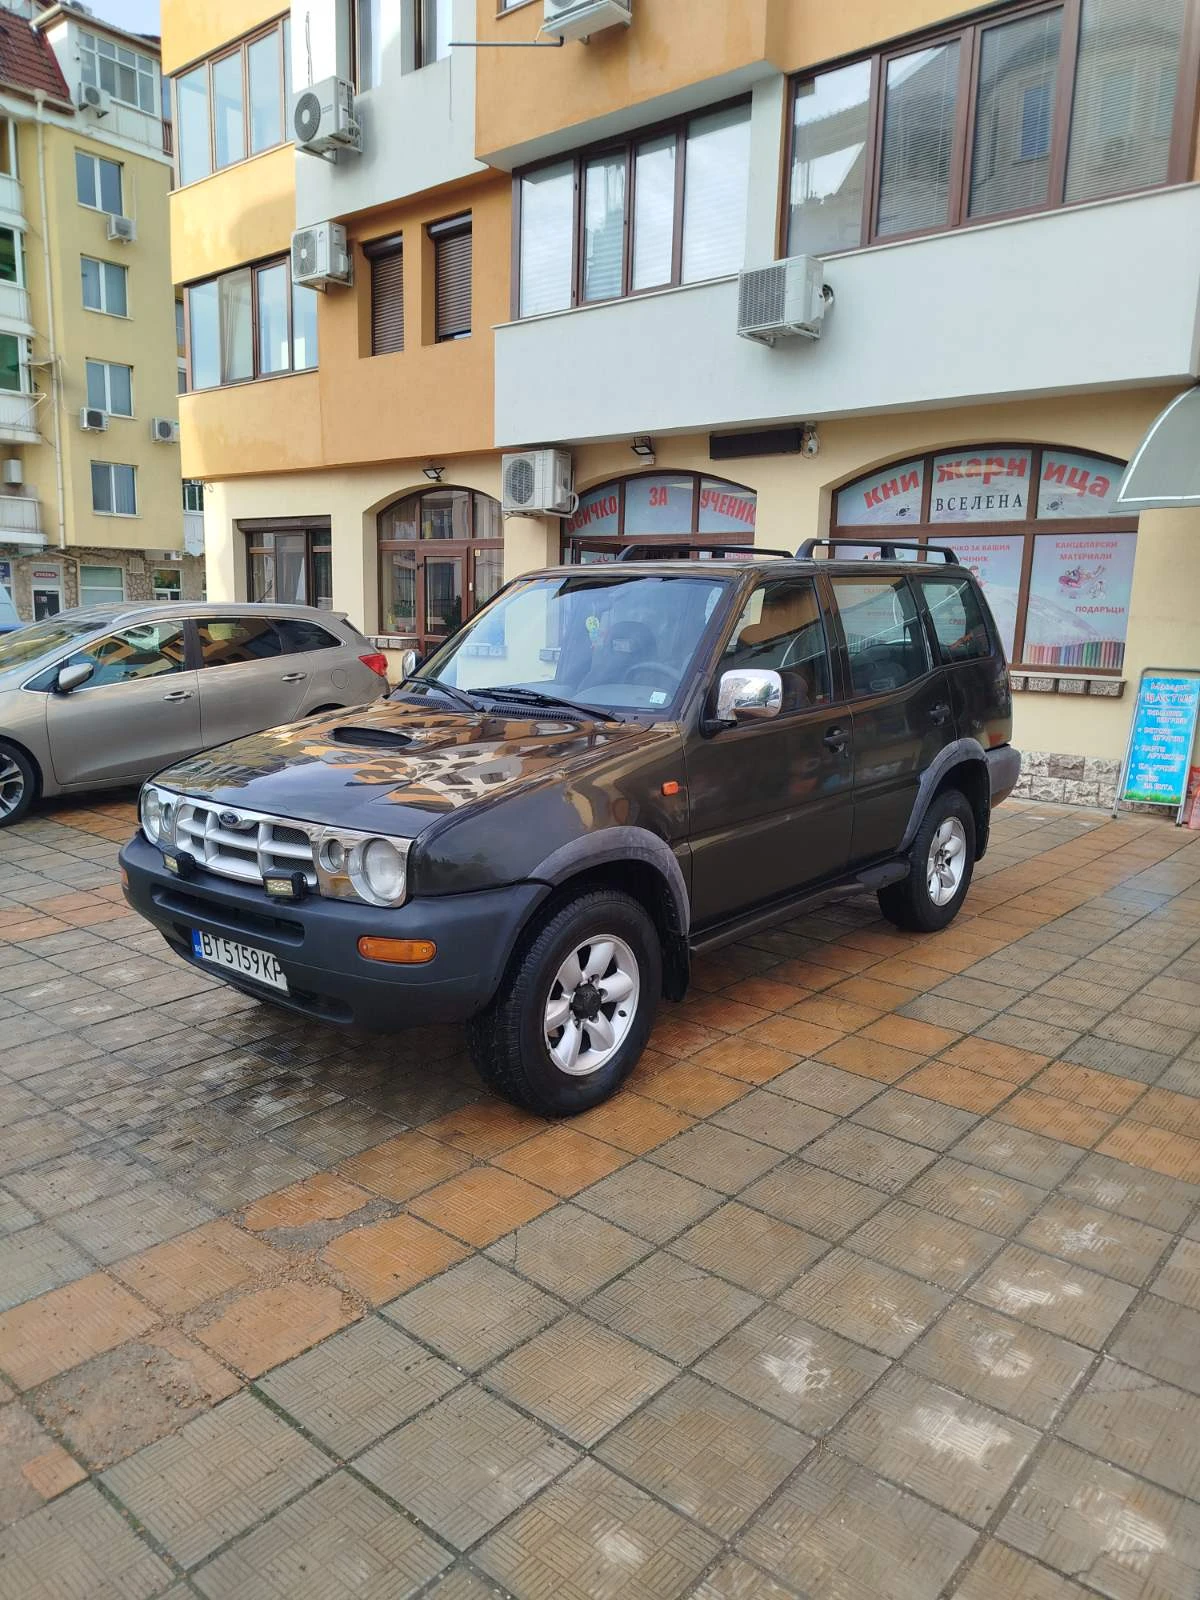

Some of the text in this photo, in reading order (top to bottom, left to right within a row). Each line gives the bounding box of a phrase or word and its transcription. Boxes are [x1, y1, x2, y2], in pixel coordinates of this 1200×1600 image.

[649, 486, 668, 506] ЗА
[935, 493, 1023, 512] ВСЕЛЕНА
[1059, 553, 1113, 561] МАТЕРИАЛИ
[1075, 606, 1126, 614] ПОДАРЪЦИ
[223, 940, 260, 975] 5159
